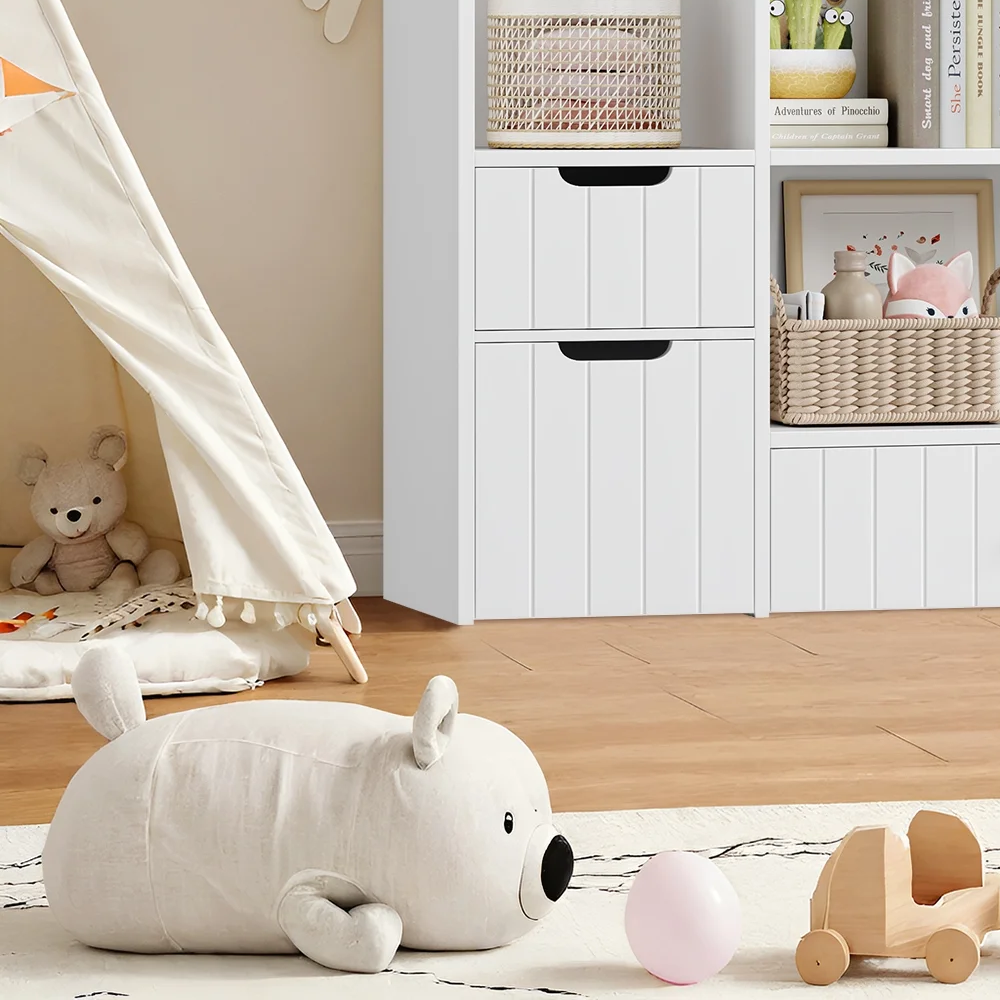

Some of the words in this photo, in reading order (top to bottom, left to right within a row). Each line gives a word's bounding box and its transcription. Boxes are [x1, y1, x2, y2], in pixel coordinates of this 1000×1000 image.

[922, 24, 932, 50] and
[976, 14, 984, 58] JUNGLE
[922, 57, 934, 81] dog
[976, 62, 984, 98] BOOK
[774, 106, 823, 116] Adventures
[827, 106, 836, 116] of
[841, 105, 881, 116] Pinocchio
[922, 87, 932, 129] Smart
[951, 84, 962, 113] She
[771, 132, 807, 140] Children
[809, 132, 819, 142] of
[821, 132, 854, 141] Captain
[856, 132, 881, 140] Grant
